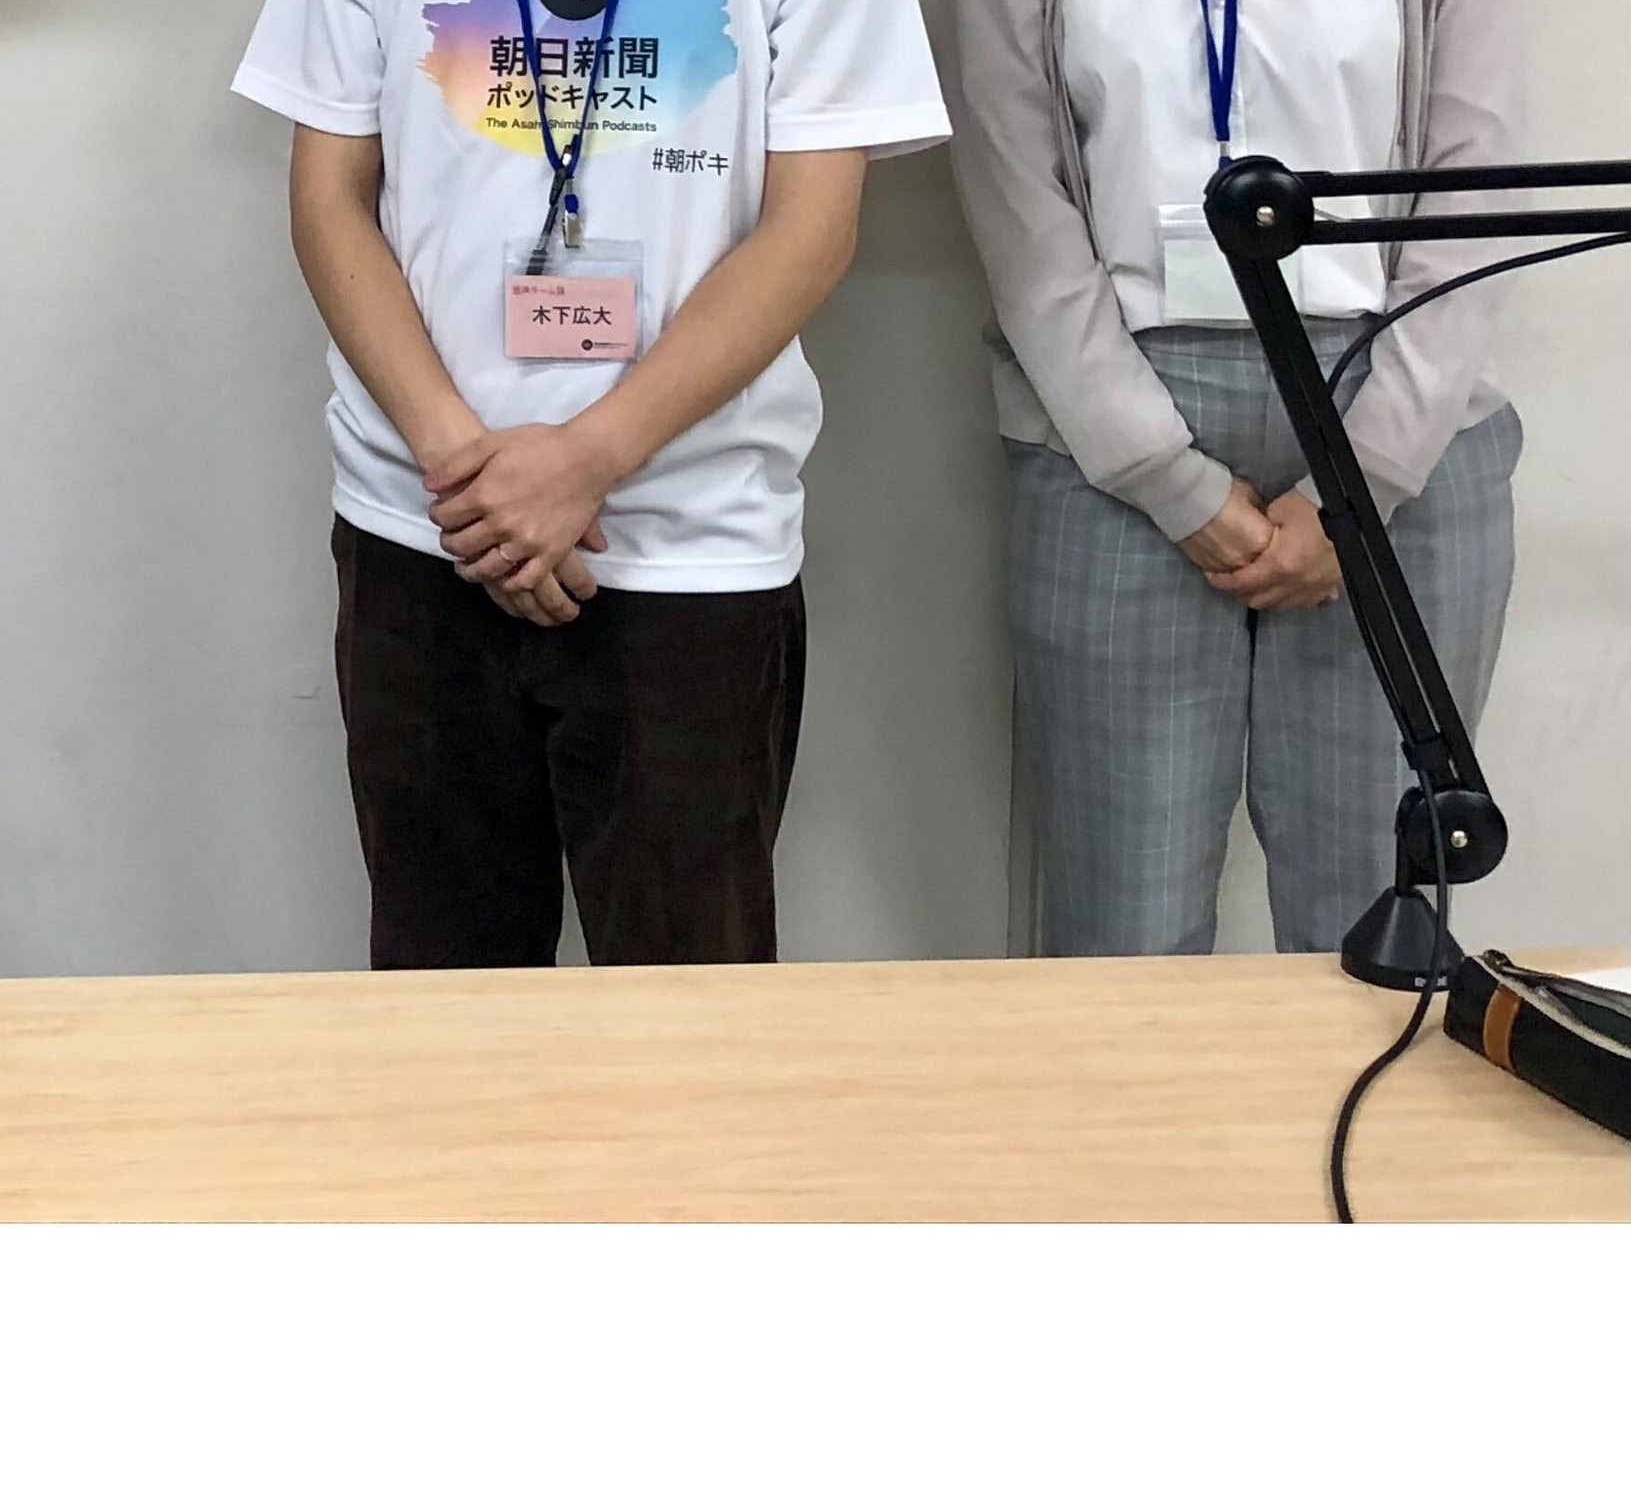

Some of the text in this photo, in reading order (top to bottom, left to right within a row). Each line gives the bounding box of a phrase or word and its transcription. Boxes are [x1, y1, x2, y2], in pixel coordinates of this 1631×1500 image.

[489, 35, 659, 79] 朝日新聞
[486, 81, 658, 111] ポッドキャスト
[486, 118, 508, 129] The
[511, 118, 542, 130] Asah
[602, 120, 657, 132] Podcasts
[651, 147, 729, 176] #朝ポキ
[532, 305, 612, 325] 木下広大
